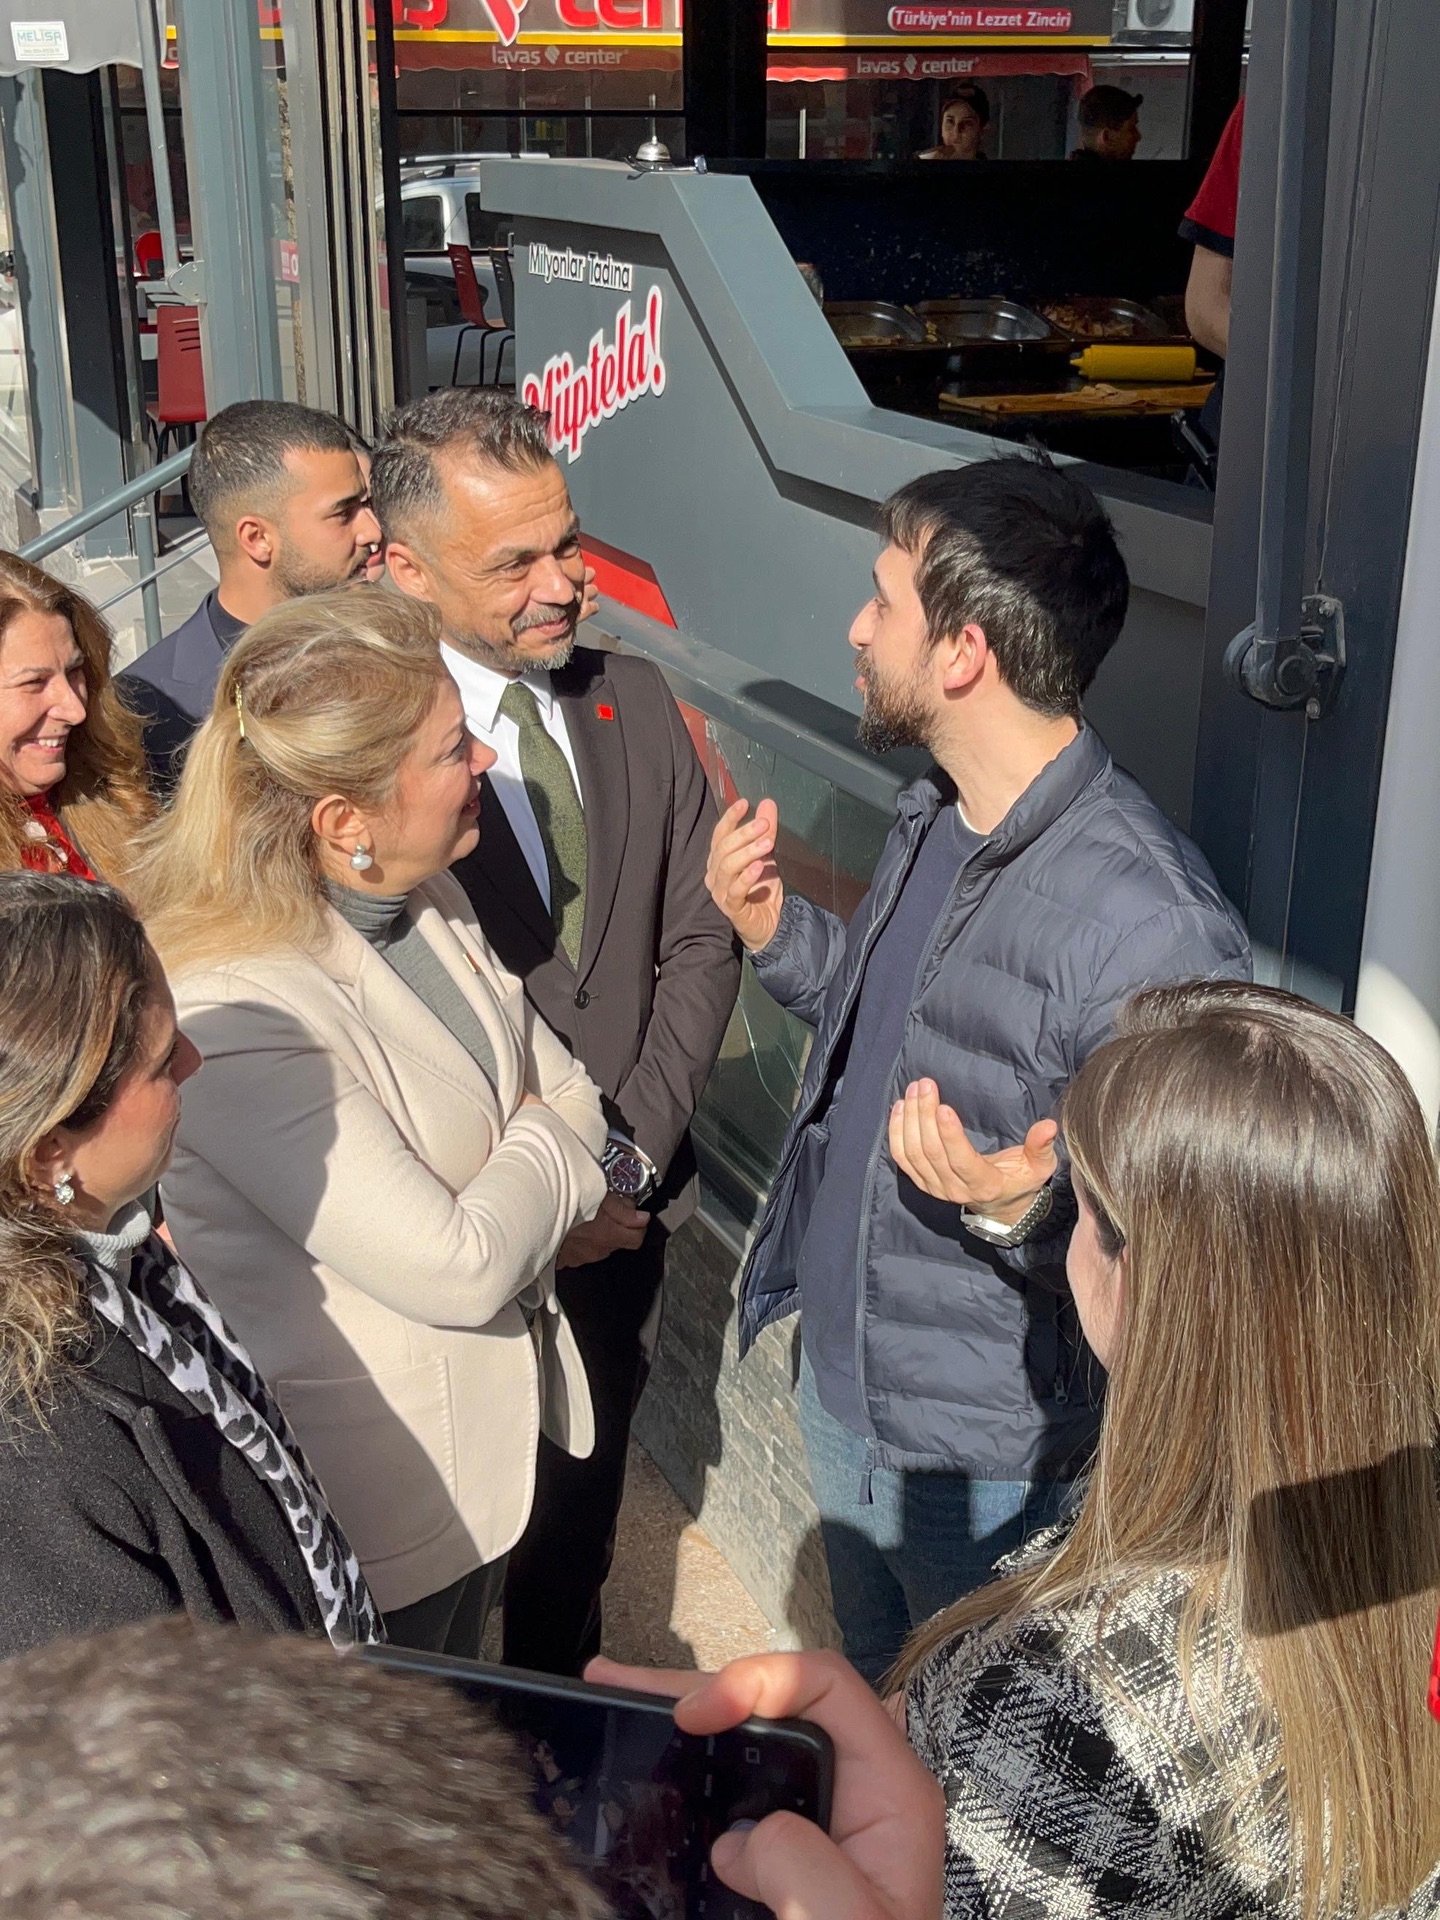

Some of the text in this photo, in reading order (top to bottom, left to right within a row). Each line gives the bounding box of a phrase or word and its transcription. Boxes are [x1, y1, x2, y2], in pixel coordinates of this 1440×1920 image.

[895, 10, 1072, 30] Türkiye'nin Lezzet Zinciri
[564, 49, 621, 65] center
[921, 58, 974, 74] center
[528, 242, 585, 284] Milyonlar
